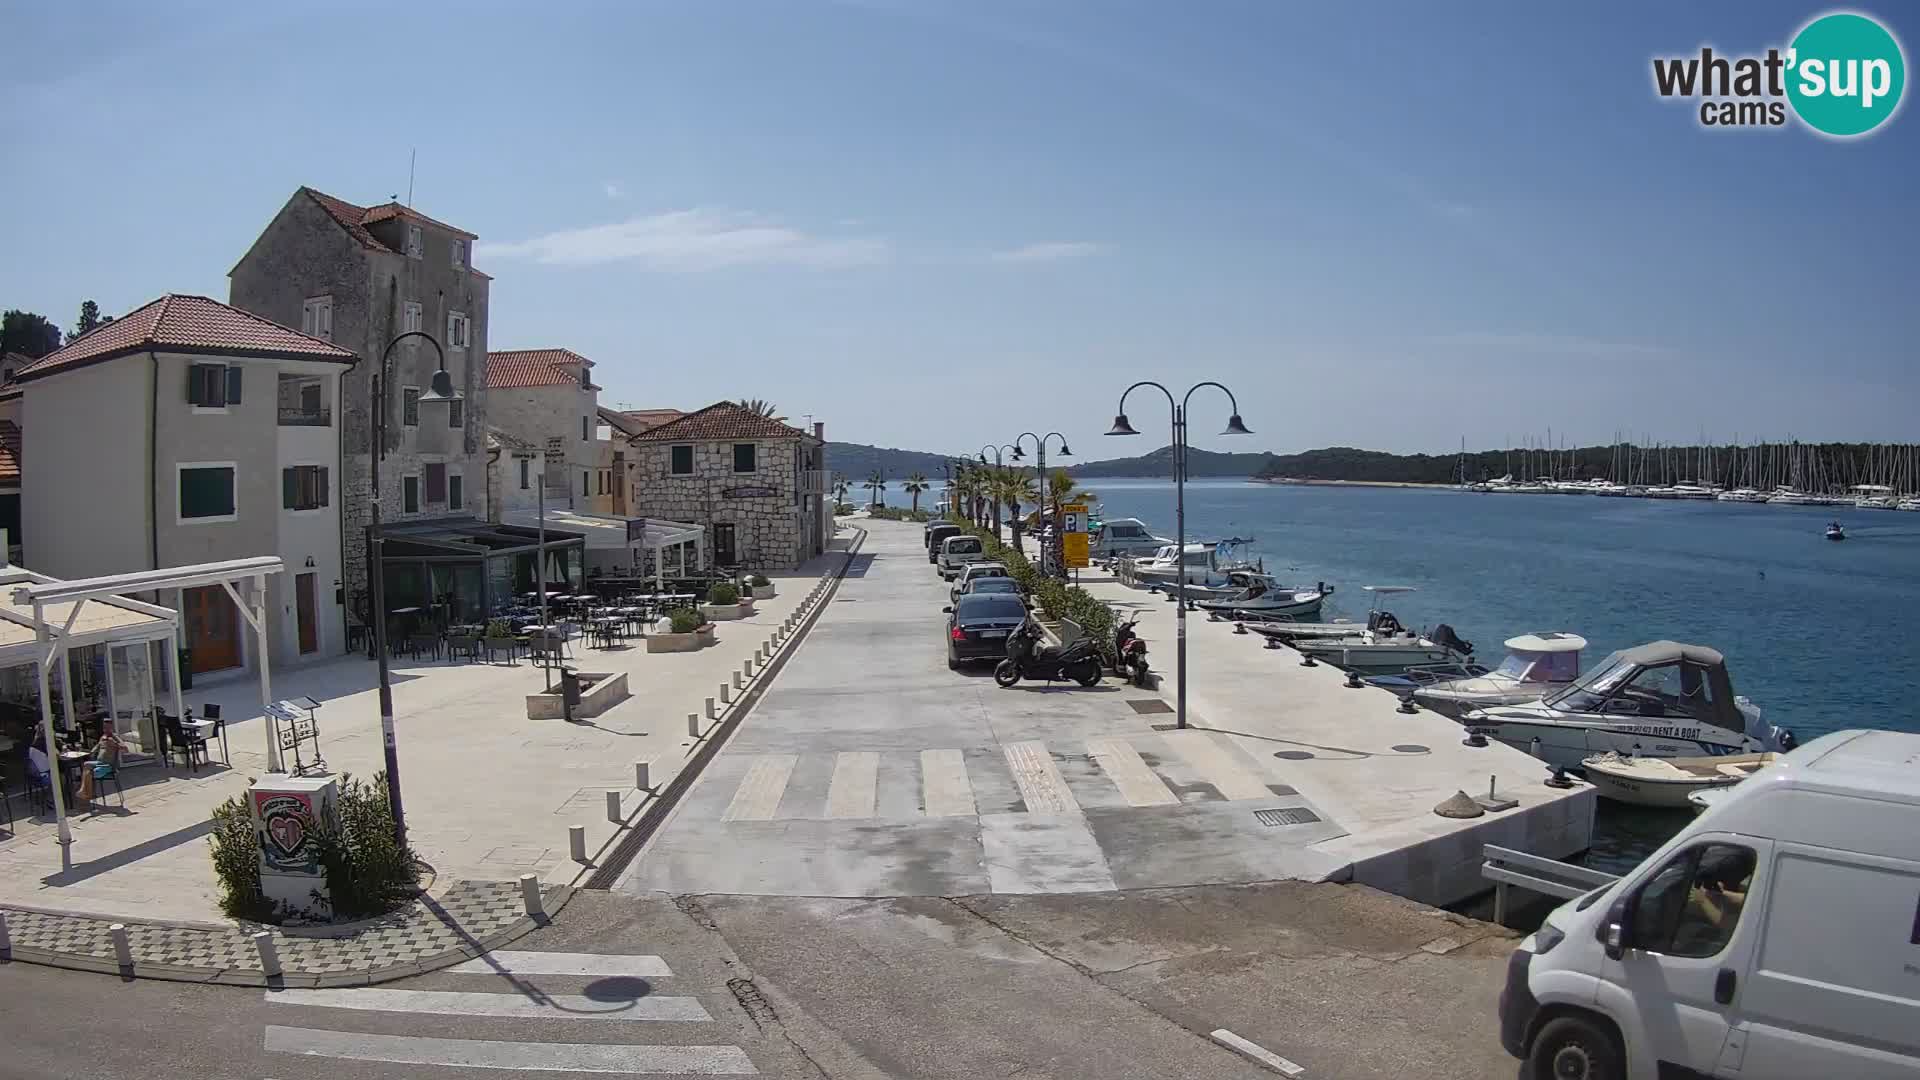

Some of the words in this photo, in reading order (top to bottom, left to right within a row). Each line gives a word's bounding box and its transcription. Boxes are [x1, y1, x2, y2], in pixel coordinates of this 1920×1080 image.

[1065, 514, 1076, 531] P
[1653, 726, 1673, 736] RENT
[1674, 728, 1680, 737] A
[1681, 728, 1701, 740] BOAT
